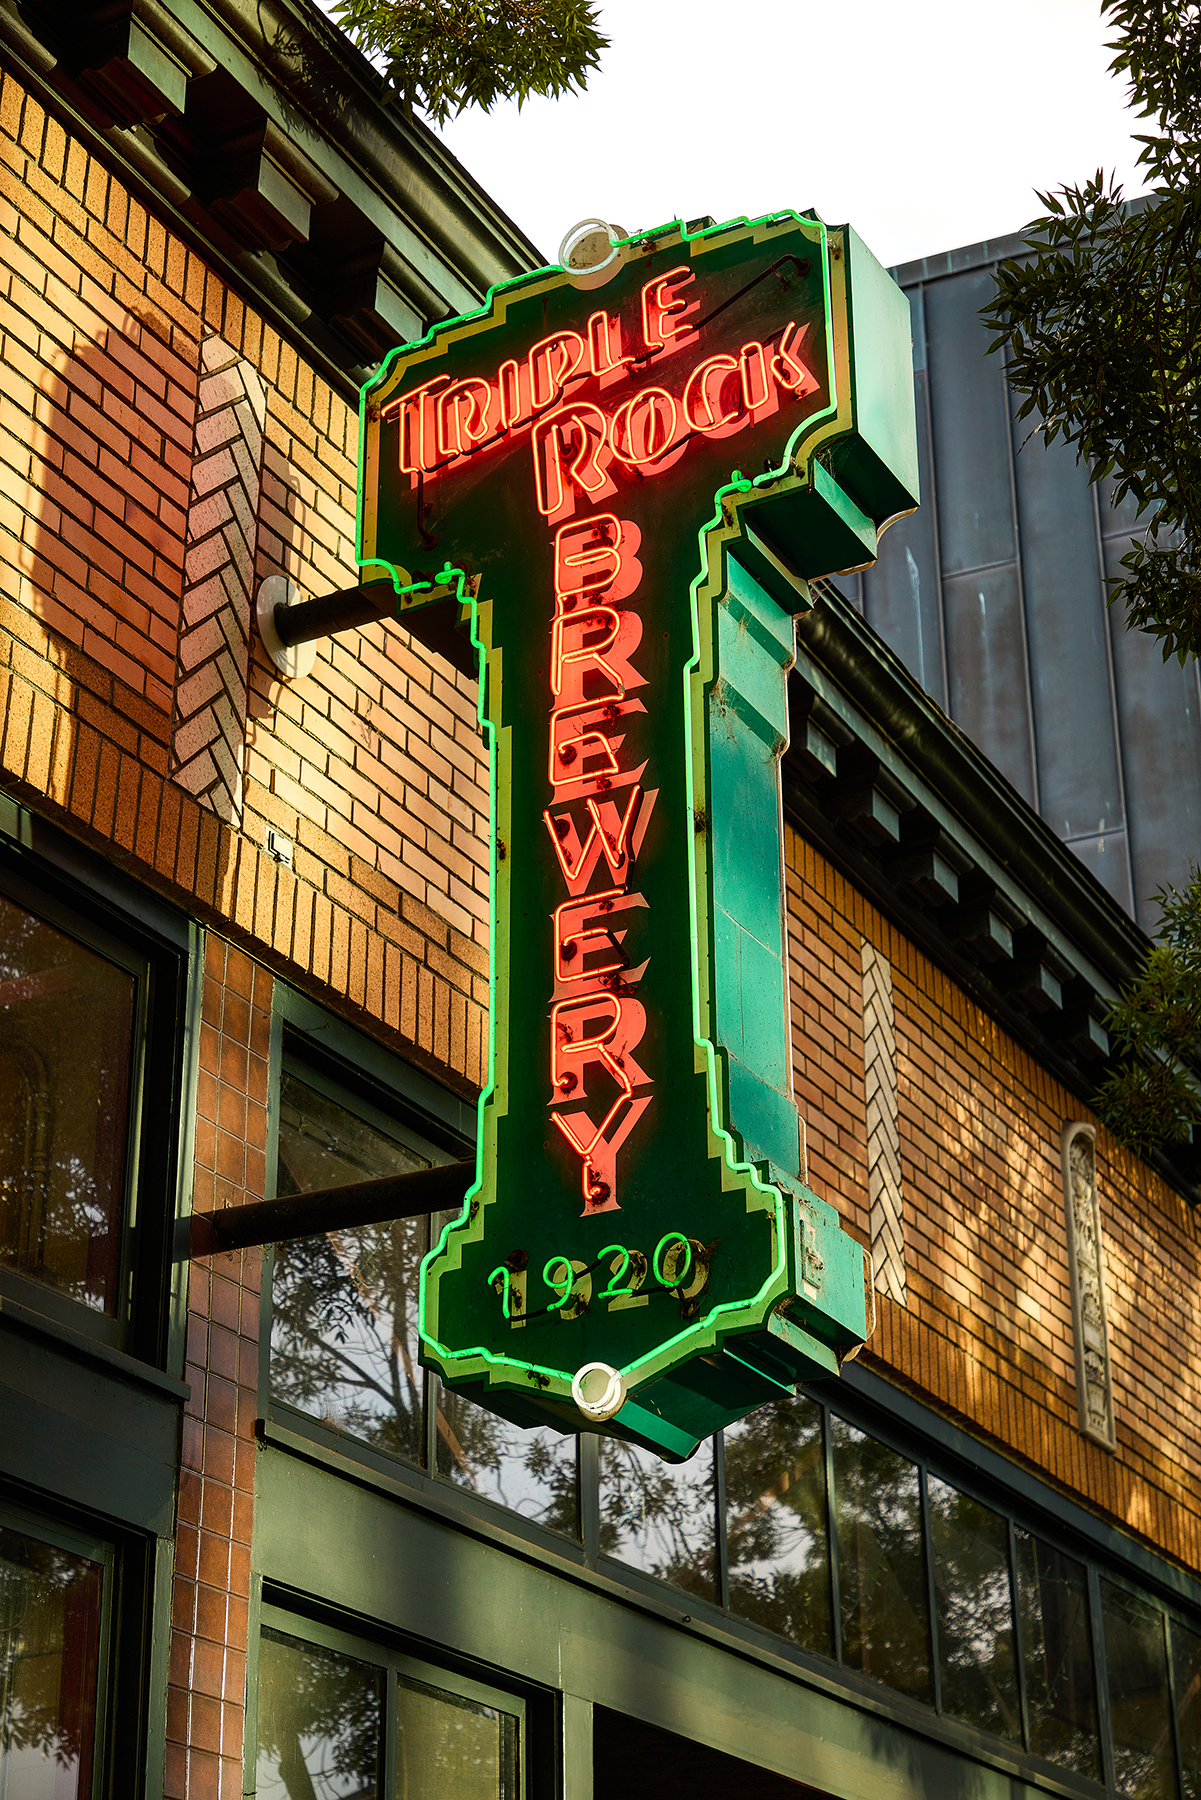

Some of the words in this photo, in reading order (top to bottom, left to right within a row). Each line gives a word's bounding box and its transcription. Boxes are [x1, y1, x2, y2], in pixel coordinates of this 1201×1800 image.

[382, 265, 700, 488] TRIPLE
[532, 321, 821, 525] ROCK
[543, 513, 660, 1217] BREWERY
[488, 1232, 708, 1328] 1920
